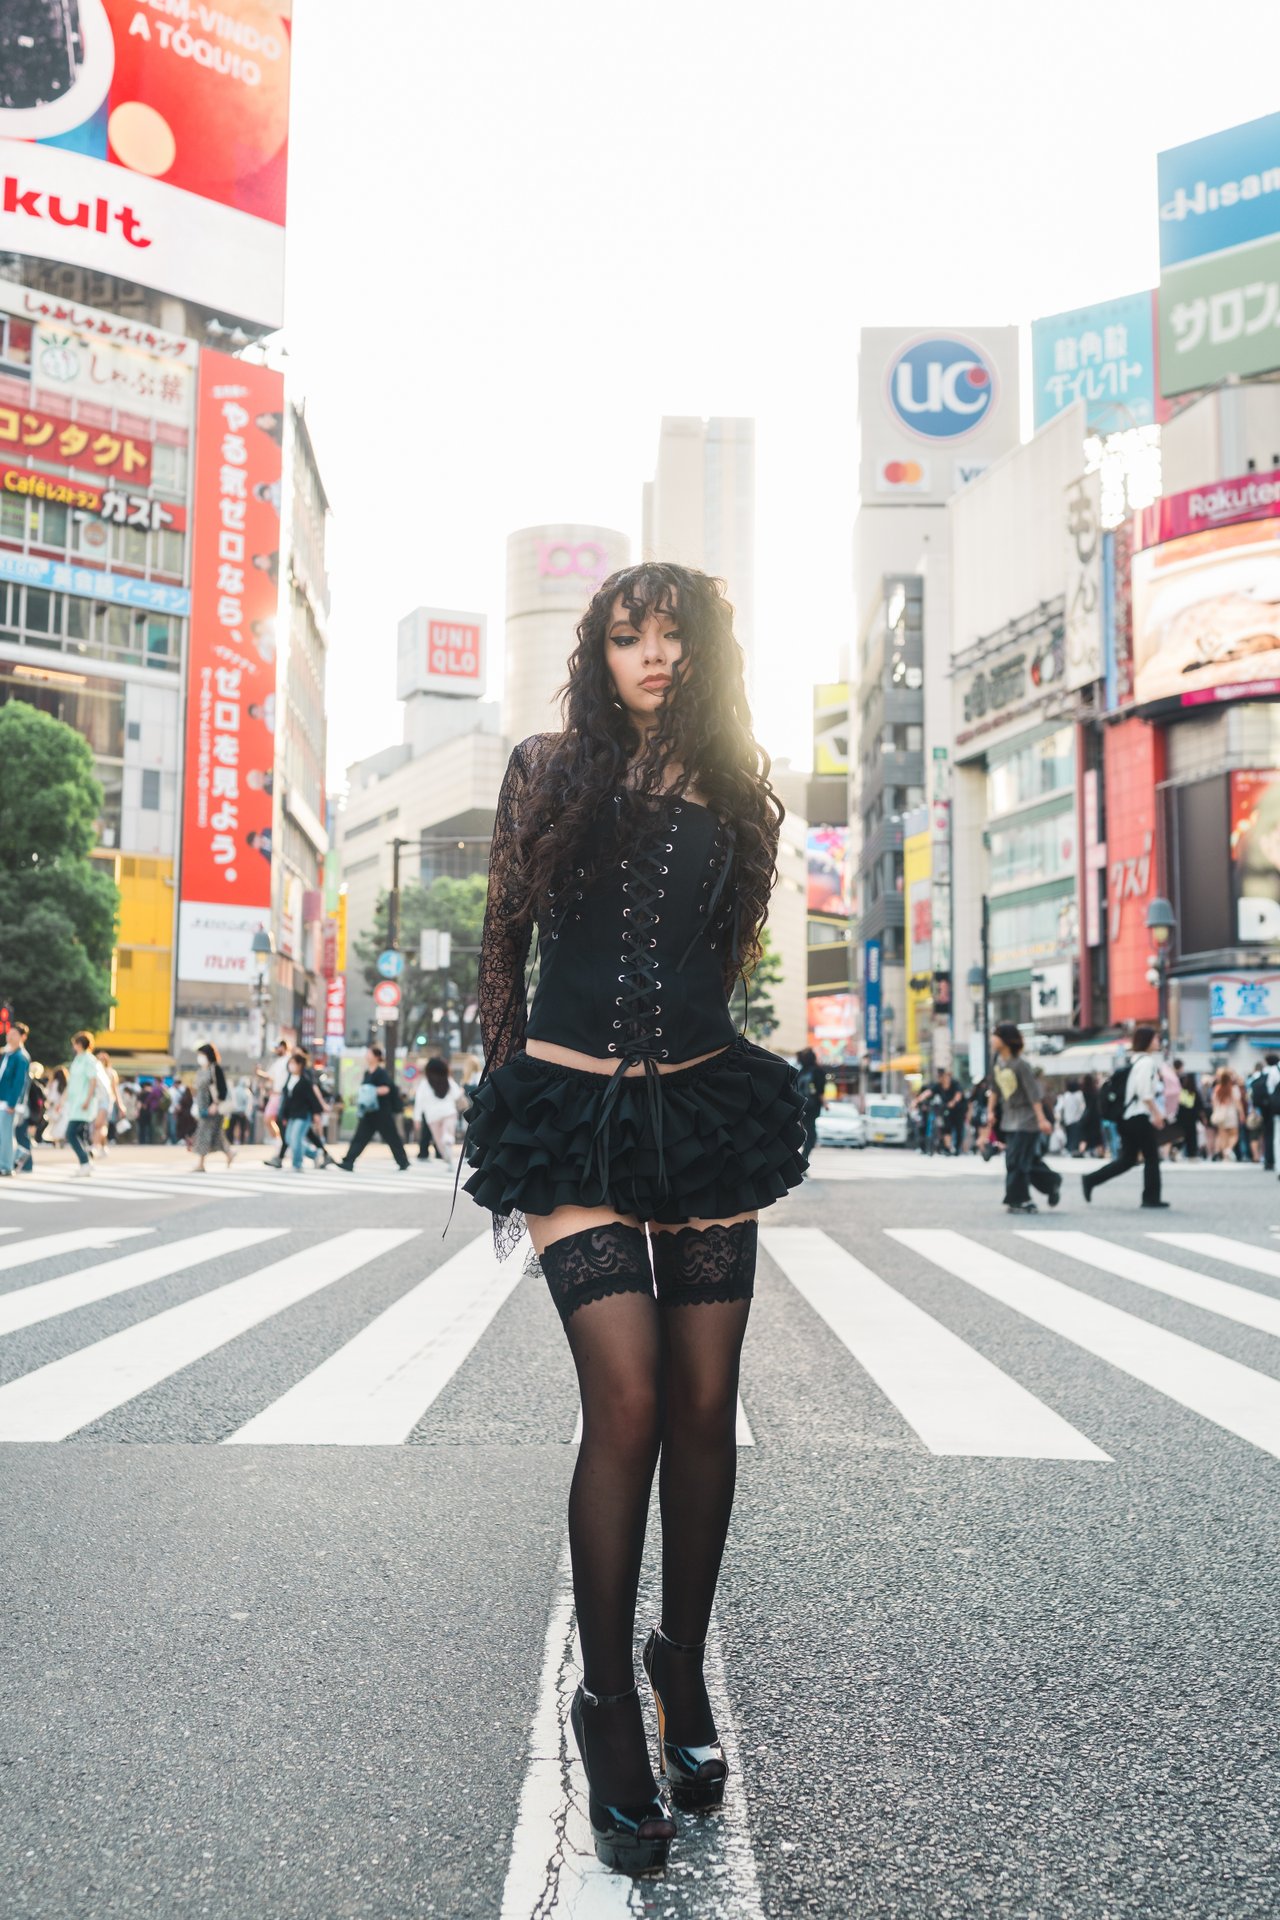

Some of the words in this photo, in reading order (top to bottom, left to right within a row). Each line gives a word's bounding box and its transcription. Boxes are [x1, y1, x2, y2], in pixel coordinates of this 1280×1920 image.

[129, 12, 151, 41] A
[155, 20, 262, 86] TÓQUIO
[136, 0, 283, 60] EM-VINDO
[4, 177, 151, 248] kult
[1170, 281, 1280, 353] サロン
[0, 408, 147, 472] コンタクト
[102, 491, 173, 531] ガスト
[1188, 481, 1280, 519] Rakute
[433, 625, 472, 649] UNI
[433, 650, 476, 673] QLO
[211, 667, 242, 882] ゼロを見よう。
